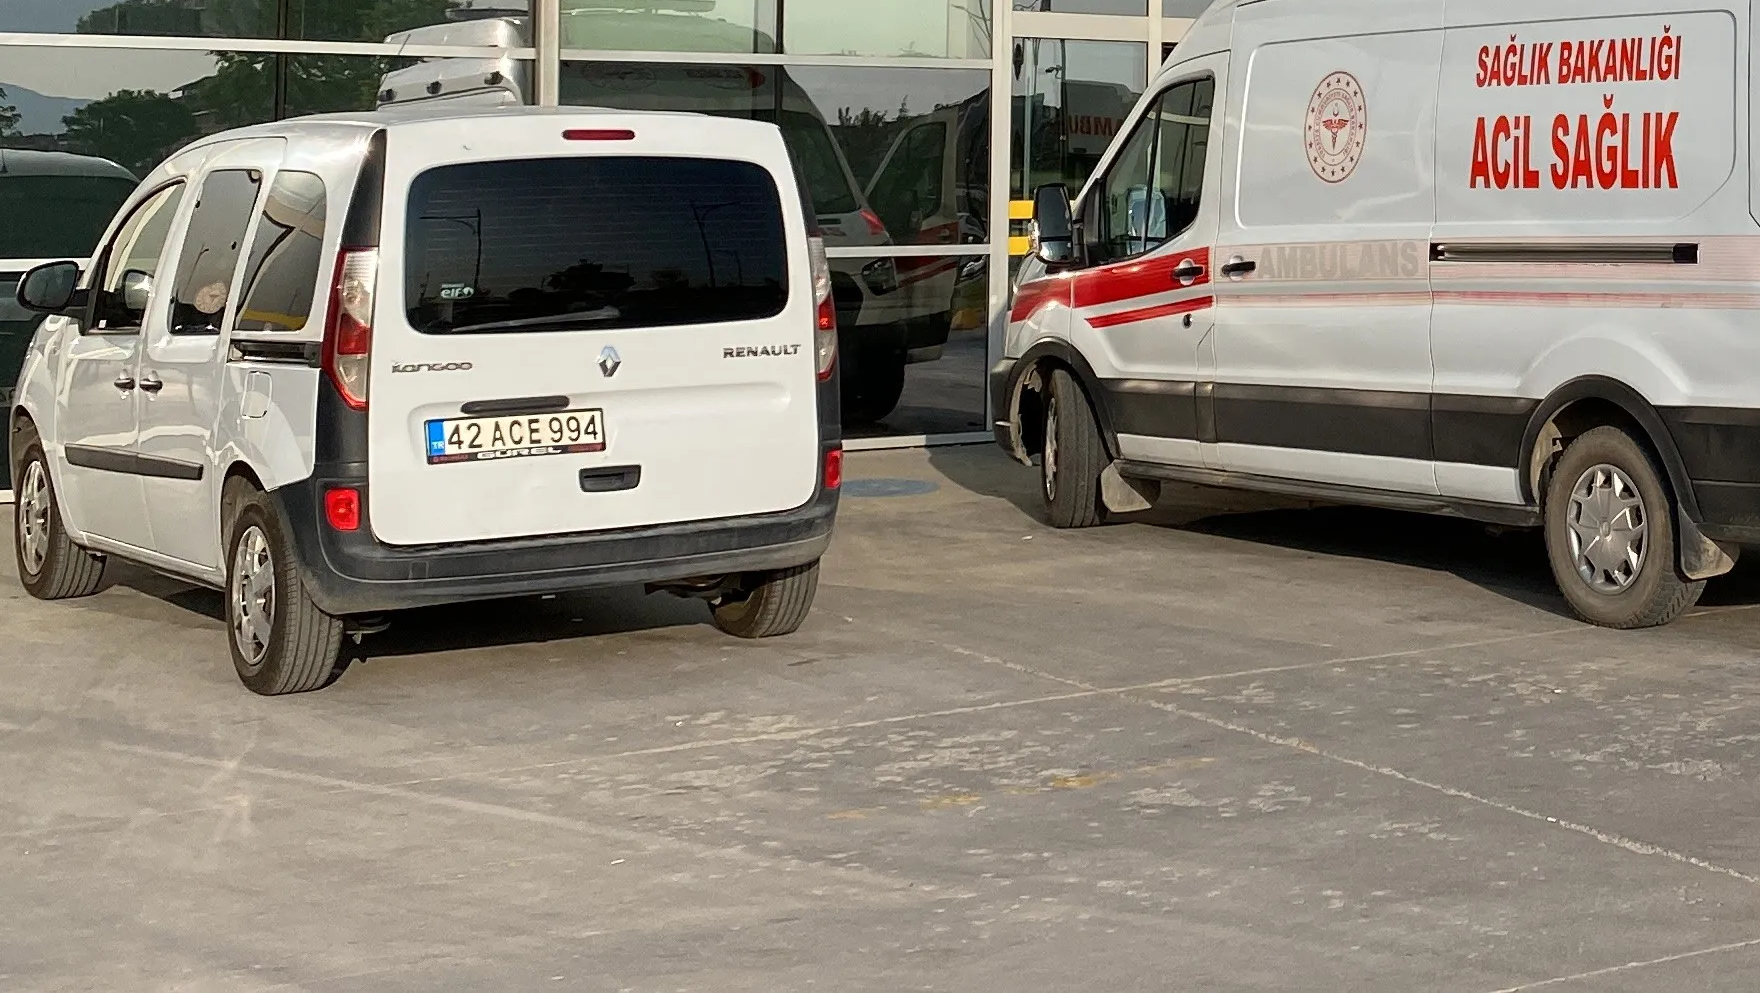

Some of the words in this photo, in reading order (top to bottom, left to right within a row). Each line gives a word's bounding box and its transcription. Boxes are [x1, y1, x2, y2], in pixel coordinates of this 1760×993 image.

[1475, 33, 1554, 88] SAĞLIK
[1557, 24, 1683, 84] BAKANLIĞI
[1550, 93, 1680, 190] SAĞLIK
[1256, 241, 1419, 279] AMBULANS
[722, 344, 802, 359] RENAULT
[447, 422, 483, 450] 42
[491, 418, 542, 448] ACE
[548, 414, 598, 444] 994
